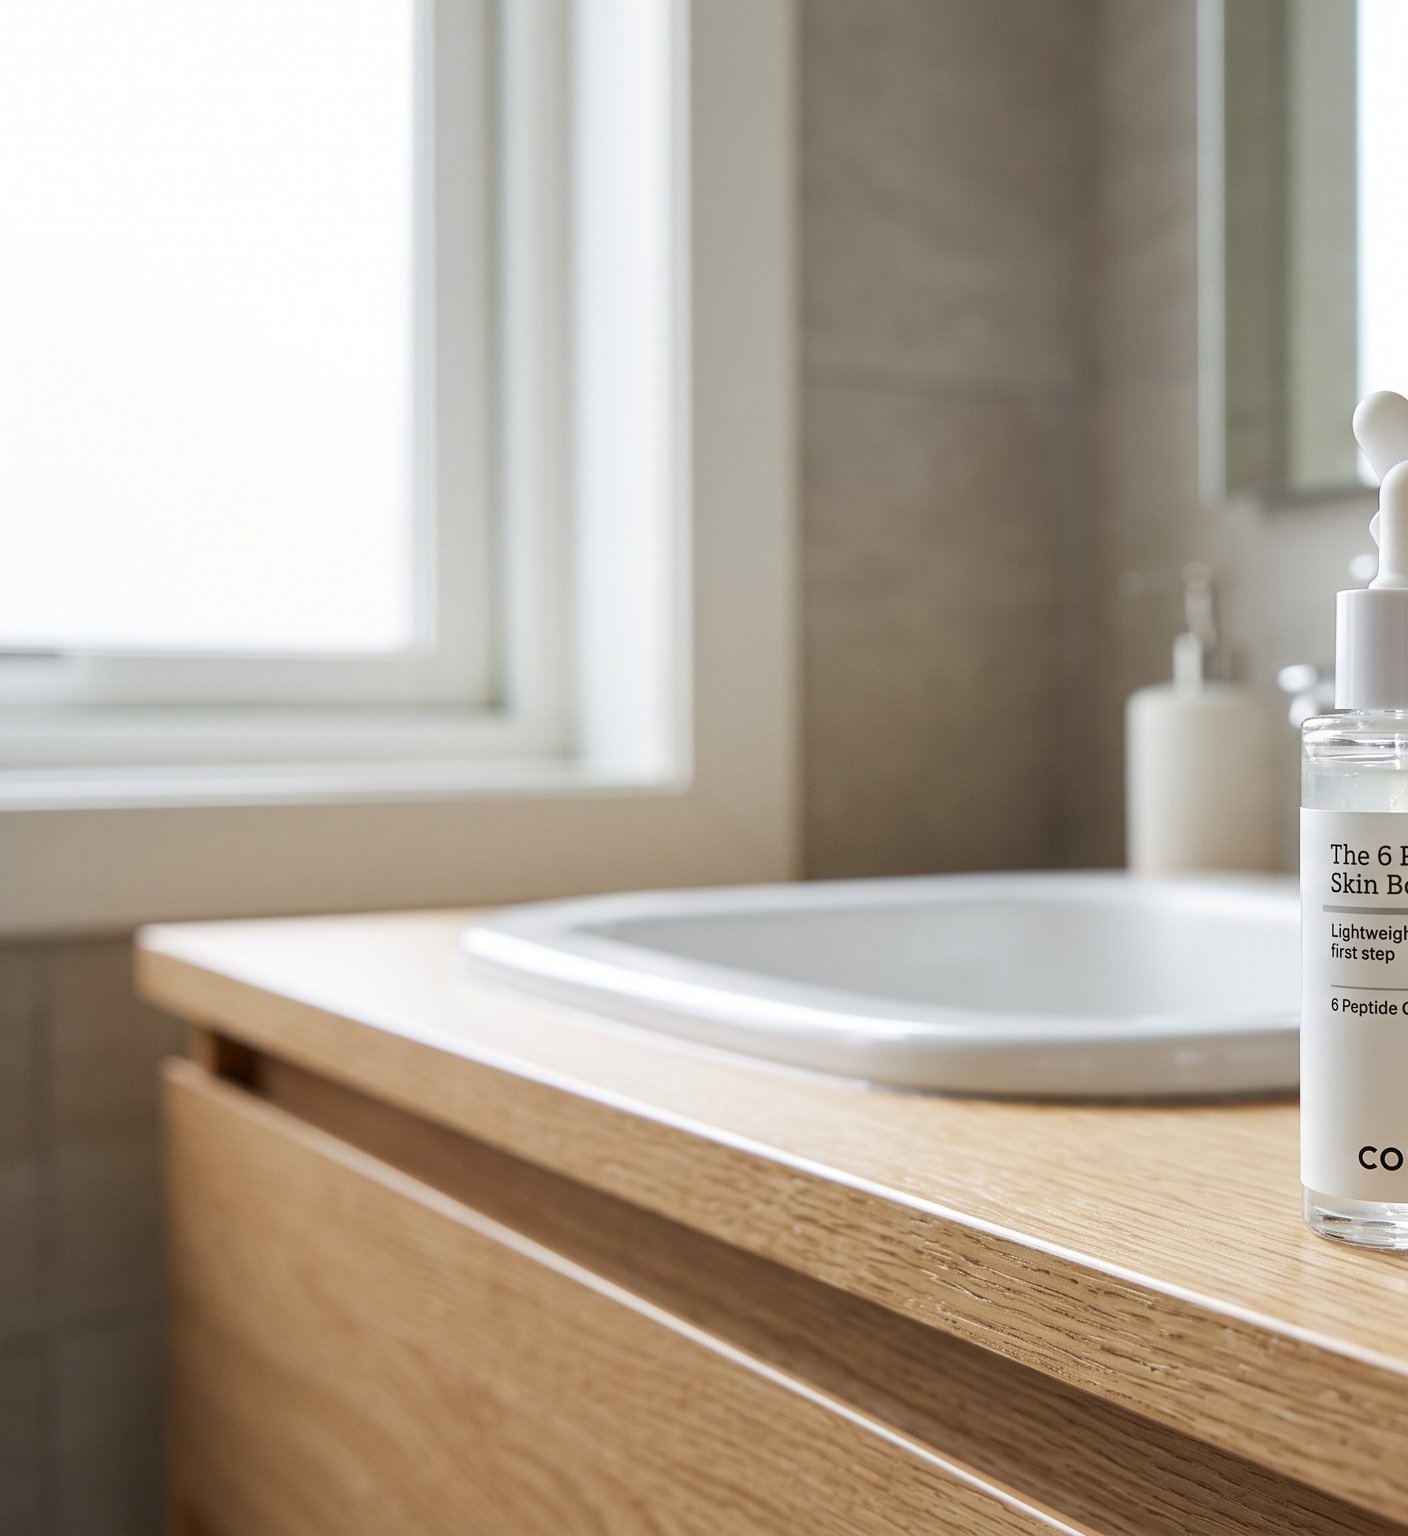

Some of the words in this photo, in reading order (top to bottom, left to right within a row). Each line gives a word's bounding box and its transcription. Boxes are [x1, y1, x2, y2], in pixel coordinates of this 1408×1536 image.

[1331, 844, 1369, 866] The
[1378, 845, 1392, 866] 6
[1331, 872, 1379, 895] Skin
[1331, 943, 1357, 960] first
[1361, 946, 1395, 964] step
[1331, 998, 1339, 1012] 6
[1342, 998, 1398, 1017] Peptide
